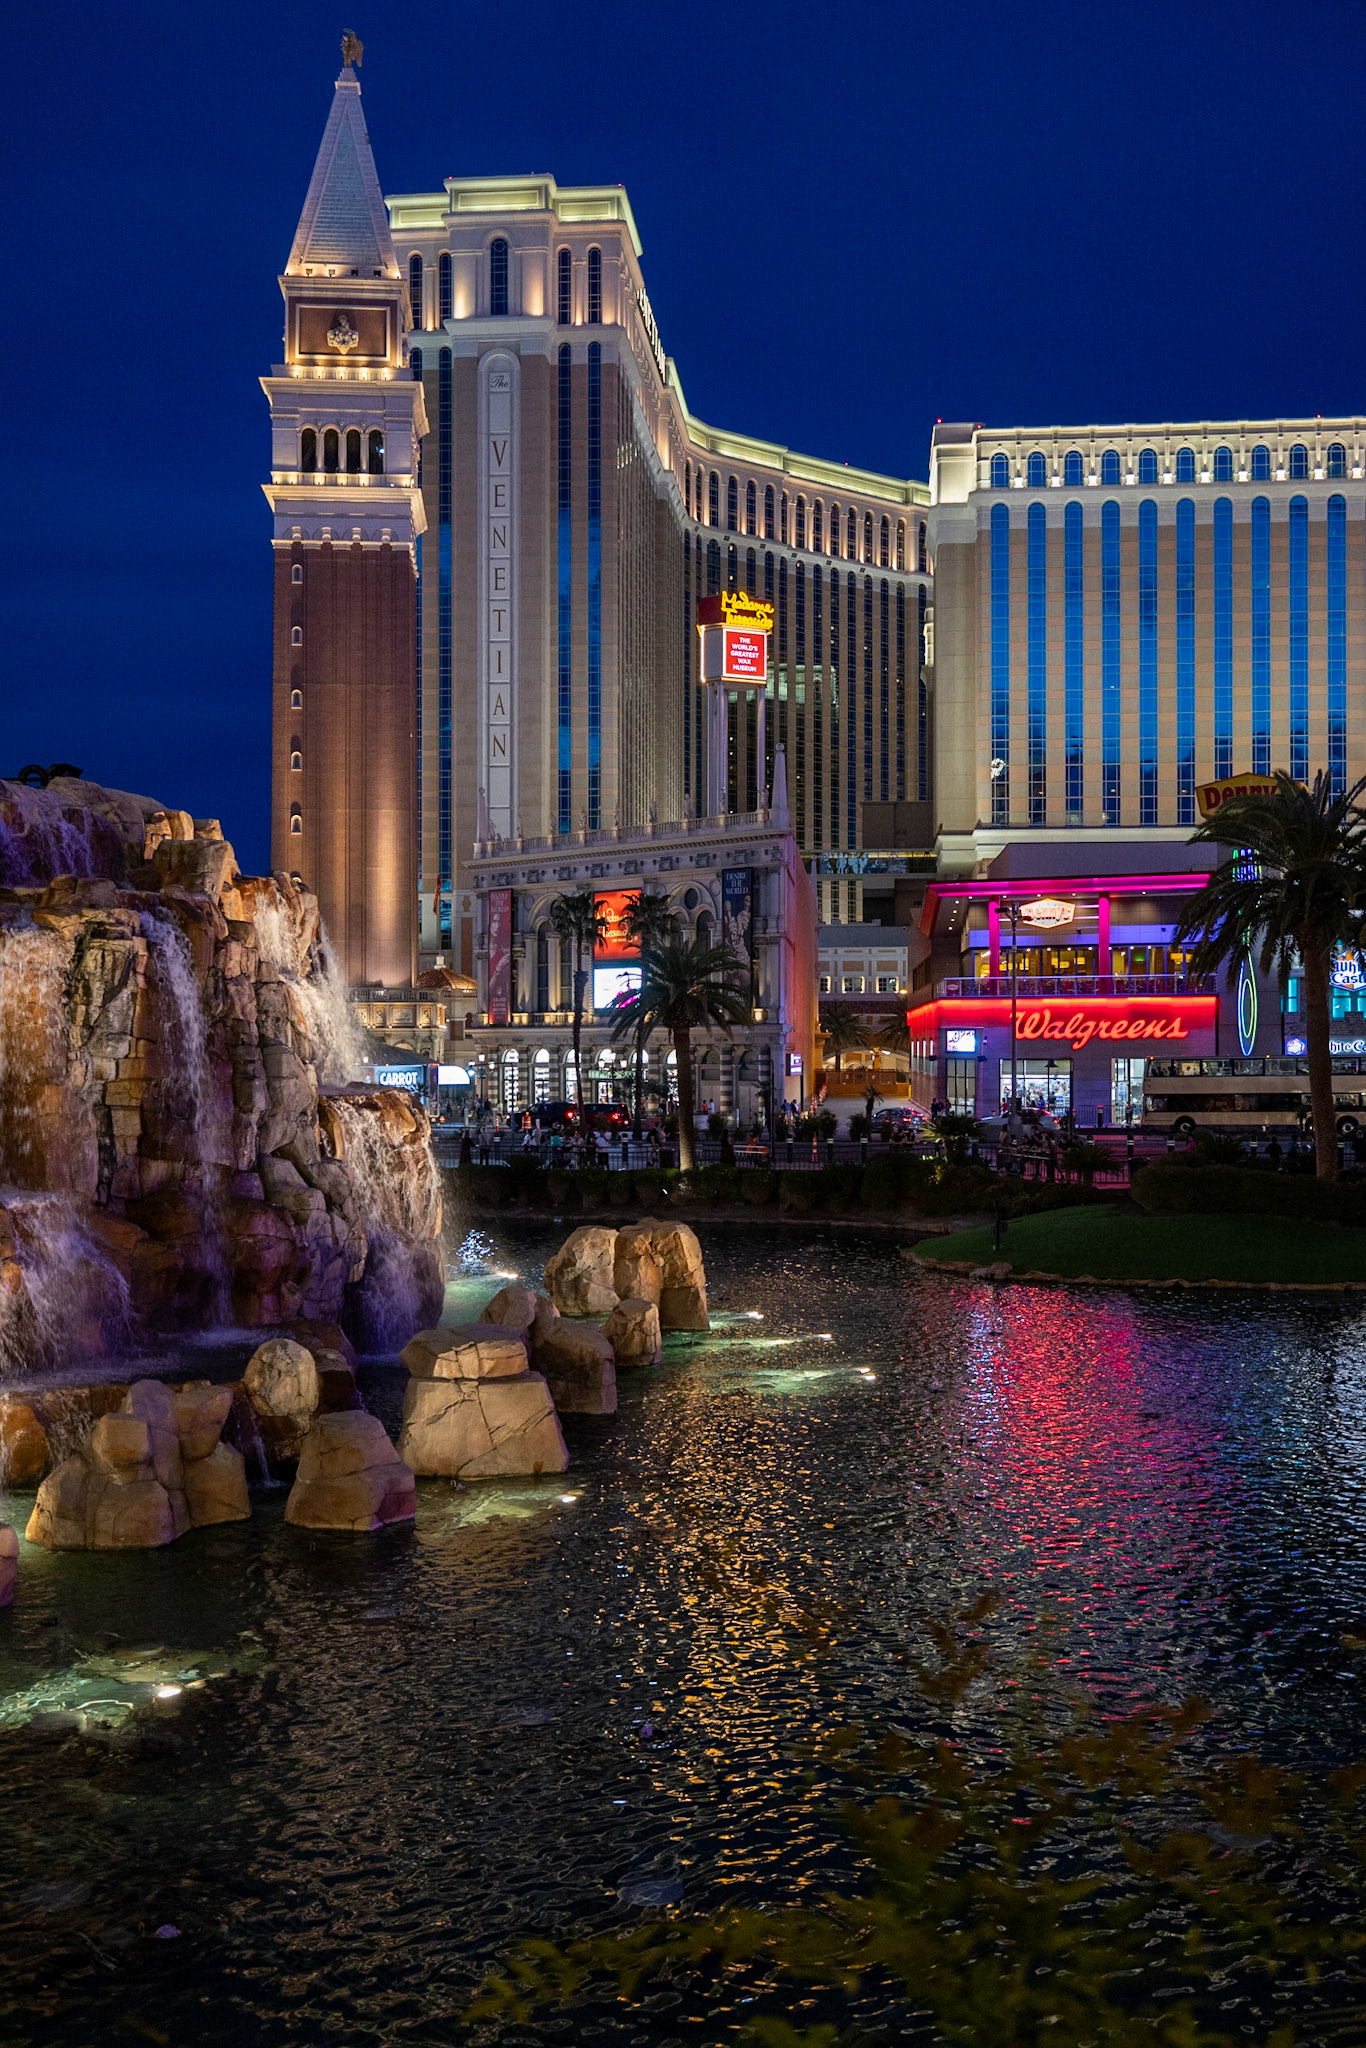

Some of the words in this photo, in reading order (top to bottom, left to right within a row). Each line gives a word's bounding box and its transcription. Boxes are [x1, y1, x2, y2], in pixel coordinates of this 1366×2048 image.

[490, 375, 509, 388] The
[491, 440, 508, 758] VENETIAN
[721, 590, 774, 613] Madame
[721, 607, 774, 629] Tussauds
[731, 643, 758, 652] WORLD'S
[730, 650, 759, 659] GREATEST
[732, 664, 757, 672] MUSEUM
[726, 872, 748, 881] DESIRE
[731, 880, 744, 888] THE
[725, 887, 749, 895] WORLD
[1009, 1008, 1189, 1050] Walgreens
[1329, 1040, 1351, 1054] hite
[379, 1071, 418, 1086] CARROT
